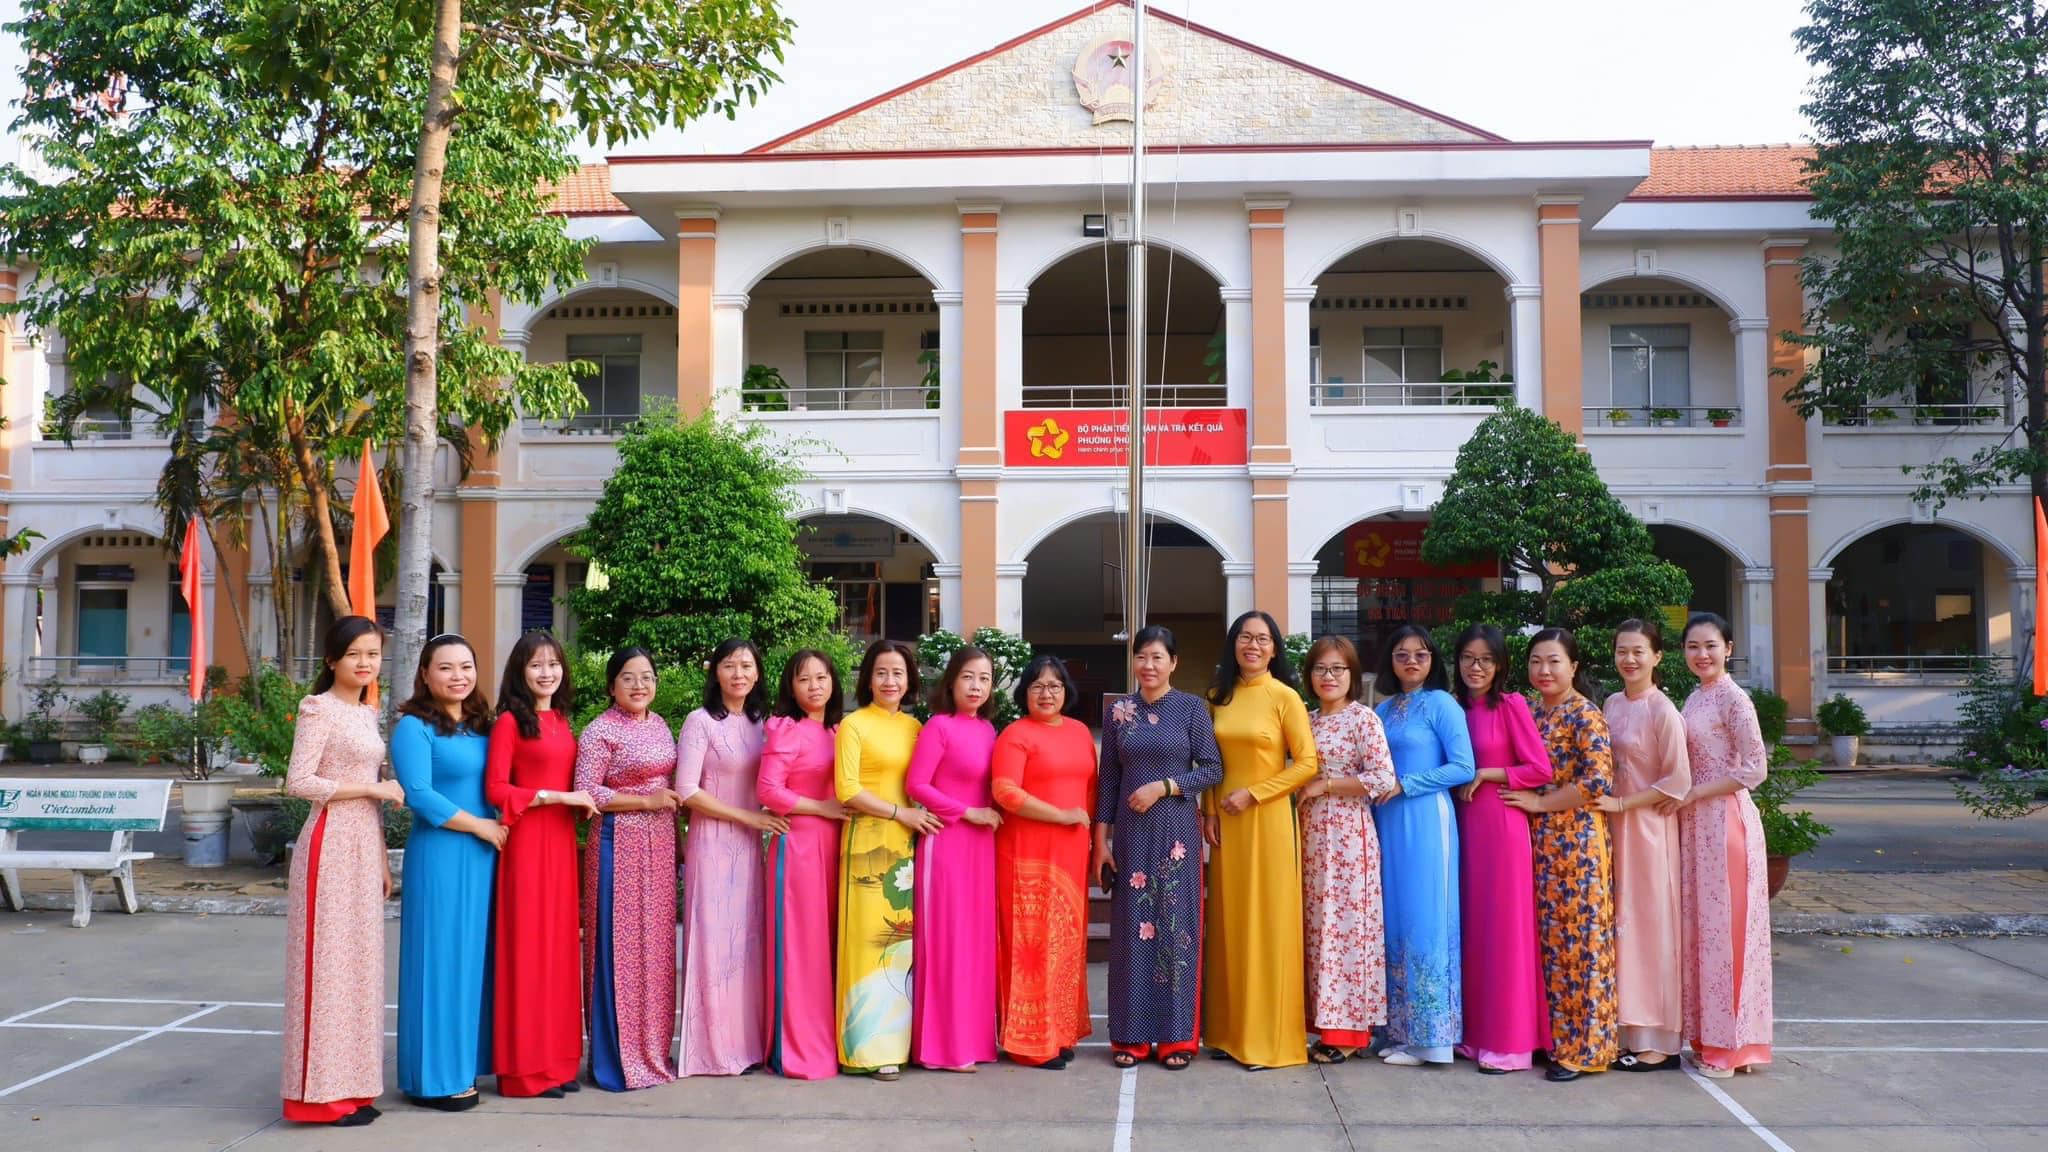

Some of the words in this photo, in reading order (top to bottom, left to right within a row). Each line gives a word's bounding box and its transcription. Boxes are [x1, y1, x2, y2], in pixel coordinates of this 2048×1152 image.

[1077, 423, 1089, 434] BỘ
[1091, 423, 1113, 433] PHẬN
[1159, 423, 1169, 433] VÀ
[1171, 422, 1187, 432] TRẢ
[1188, 421, 1204, 432] KẾT
[1206, 422, 1224, 433] QUẢ
[26, 788, 42, 798] NGÂN
[43, 788, 59, 798] HÀNG
[79, 790, 102, 799] THƯƠNG
[118, 790, 138, 799] DƯƠNG
[41, 803, 117, 814] Vietcombank
